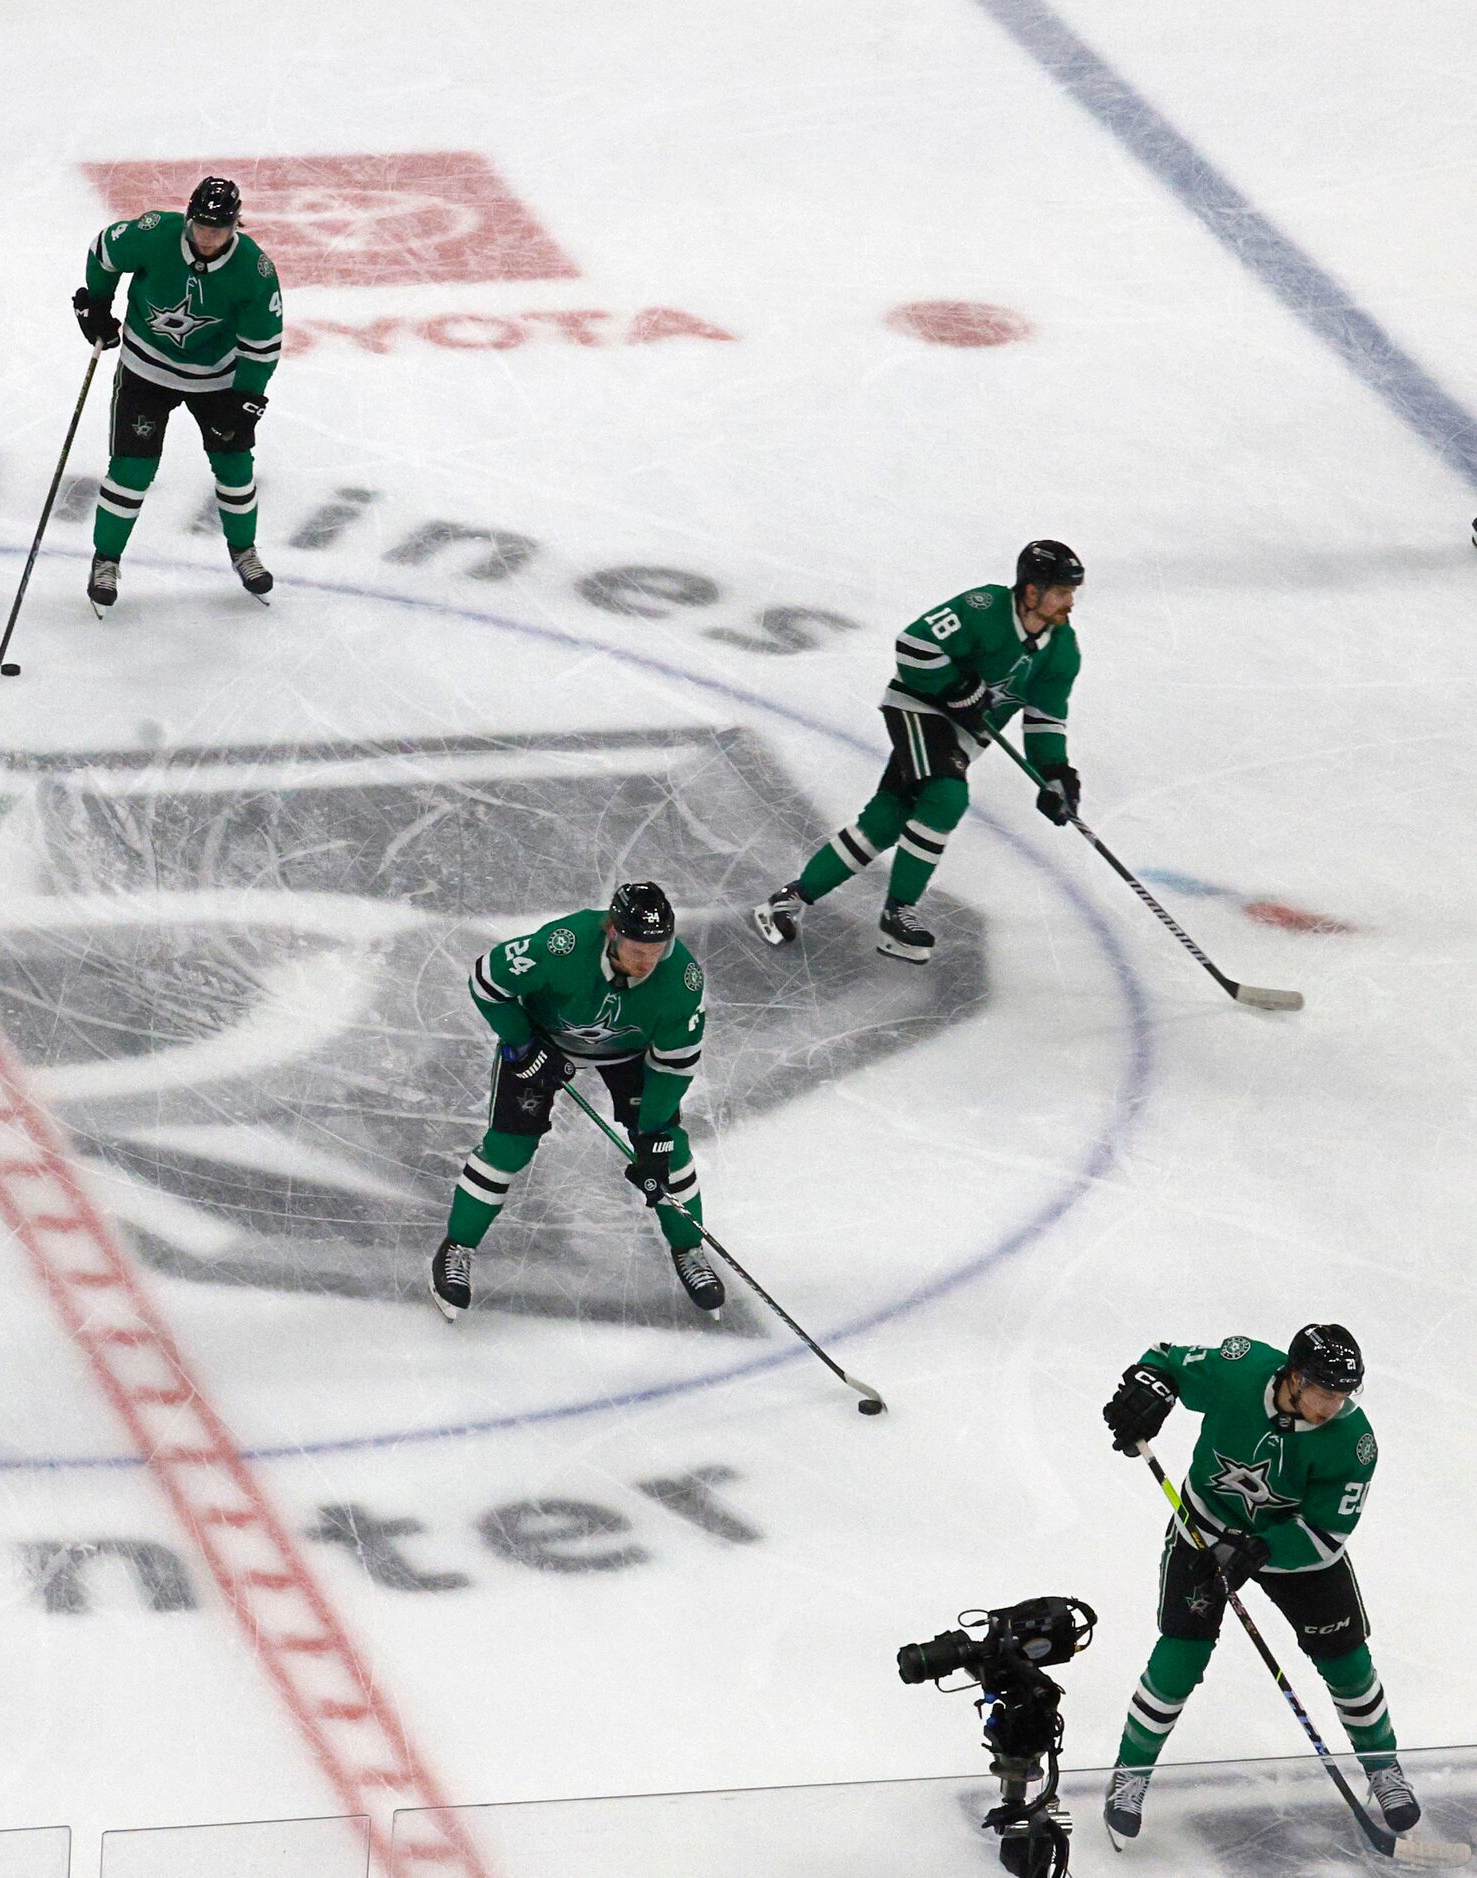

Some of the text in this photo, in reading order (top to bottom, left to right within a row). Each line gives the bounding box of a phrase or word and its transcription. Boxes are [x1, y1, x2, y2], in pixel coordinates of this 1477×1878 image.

[268, 290, 283, 317] 4
[282, 306, 744, 359] YOTA
[924, 607, 962, 641] 18
[504, 937, 537, 976] 24
[1344, 1358, 1356, 1370] 21
[1304, 1617, 1351, 1635] CCM
